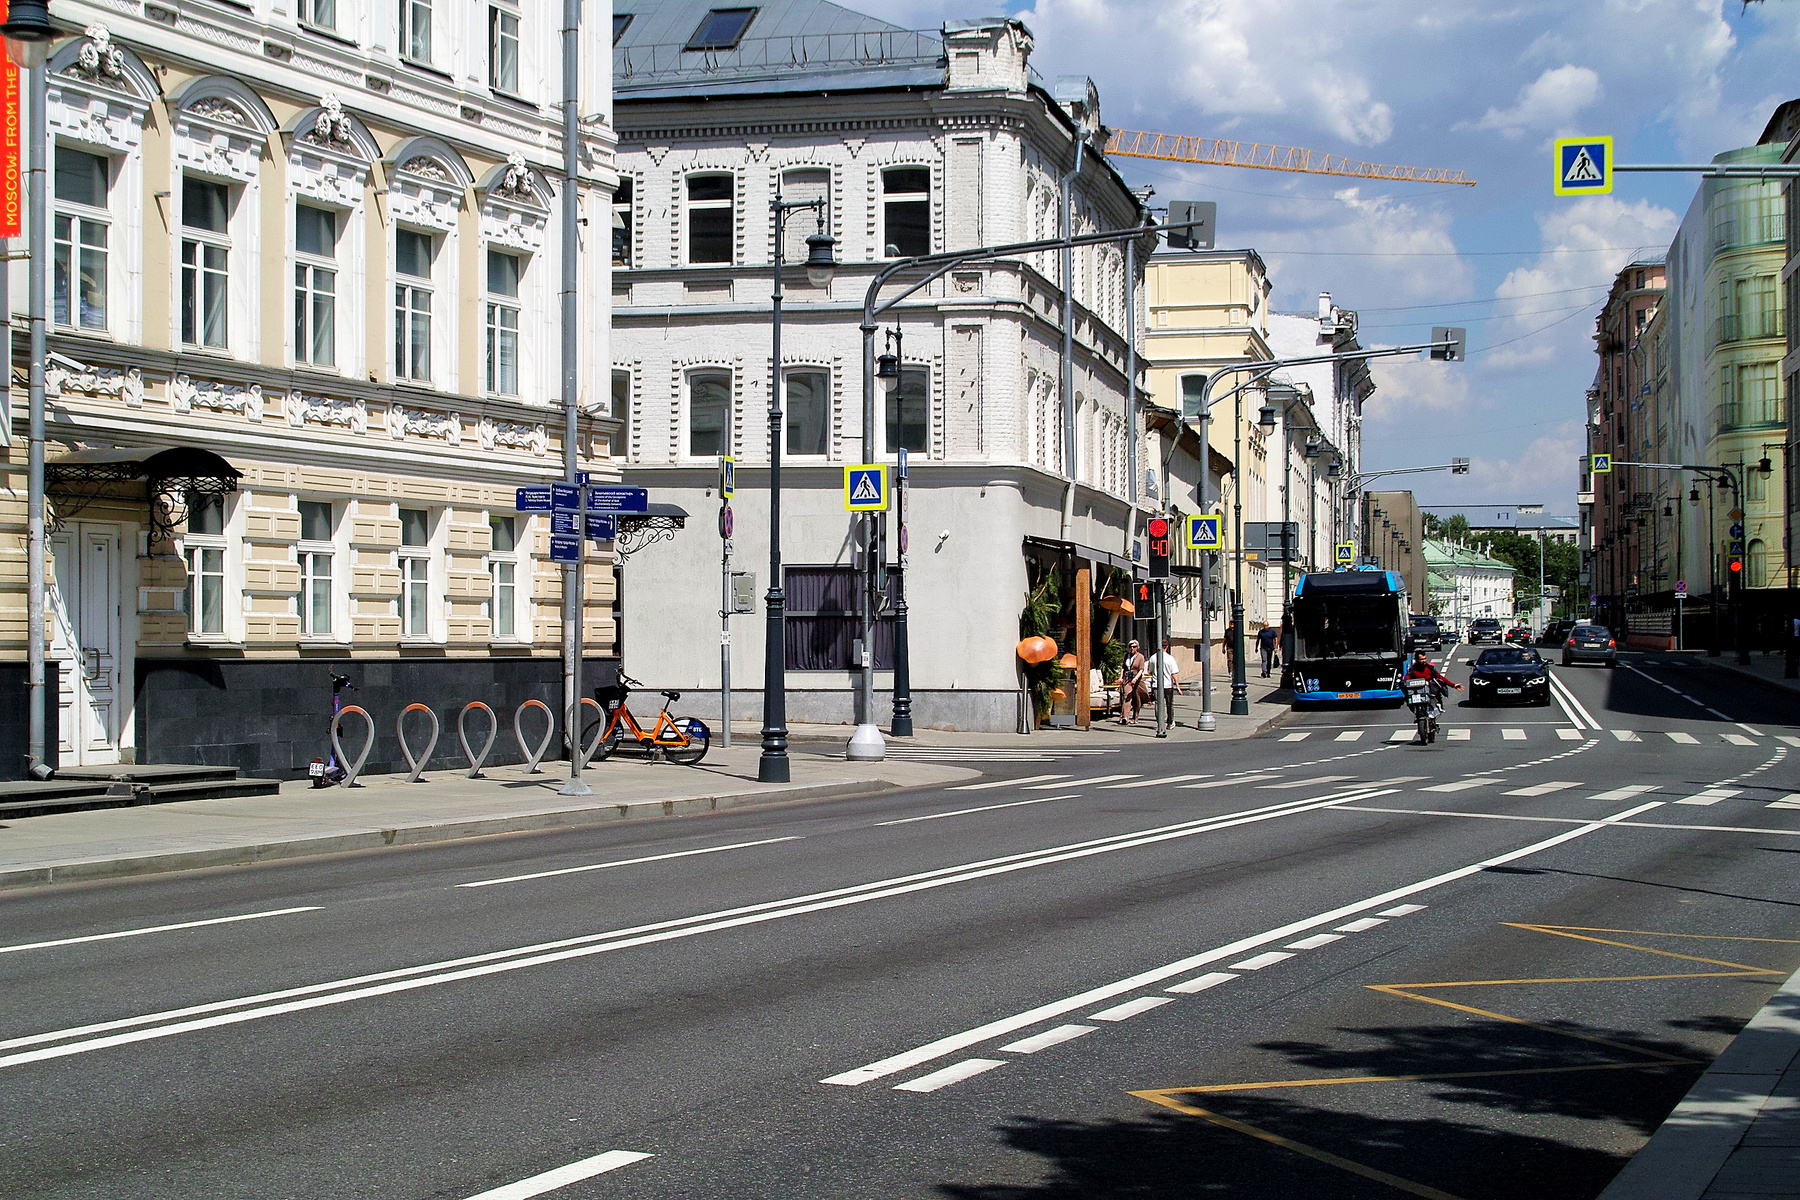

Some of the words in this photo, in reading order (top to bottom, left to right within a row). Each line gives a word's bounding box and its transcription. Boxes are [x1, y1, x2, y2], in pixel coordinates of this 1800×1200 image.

[6, 67, 17, 99] THE
[6, 102, 17, 148] FROM
[6, 151, 17, 226] MOSCOW:
[1151, 540, 1168, 556] 40
